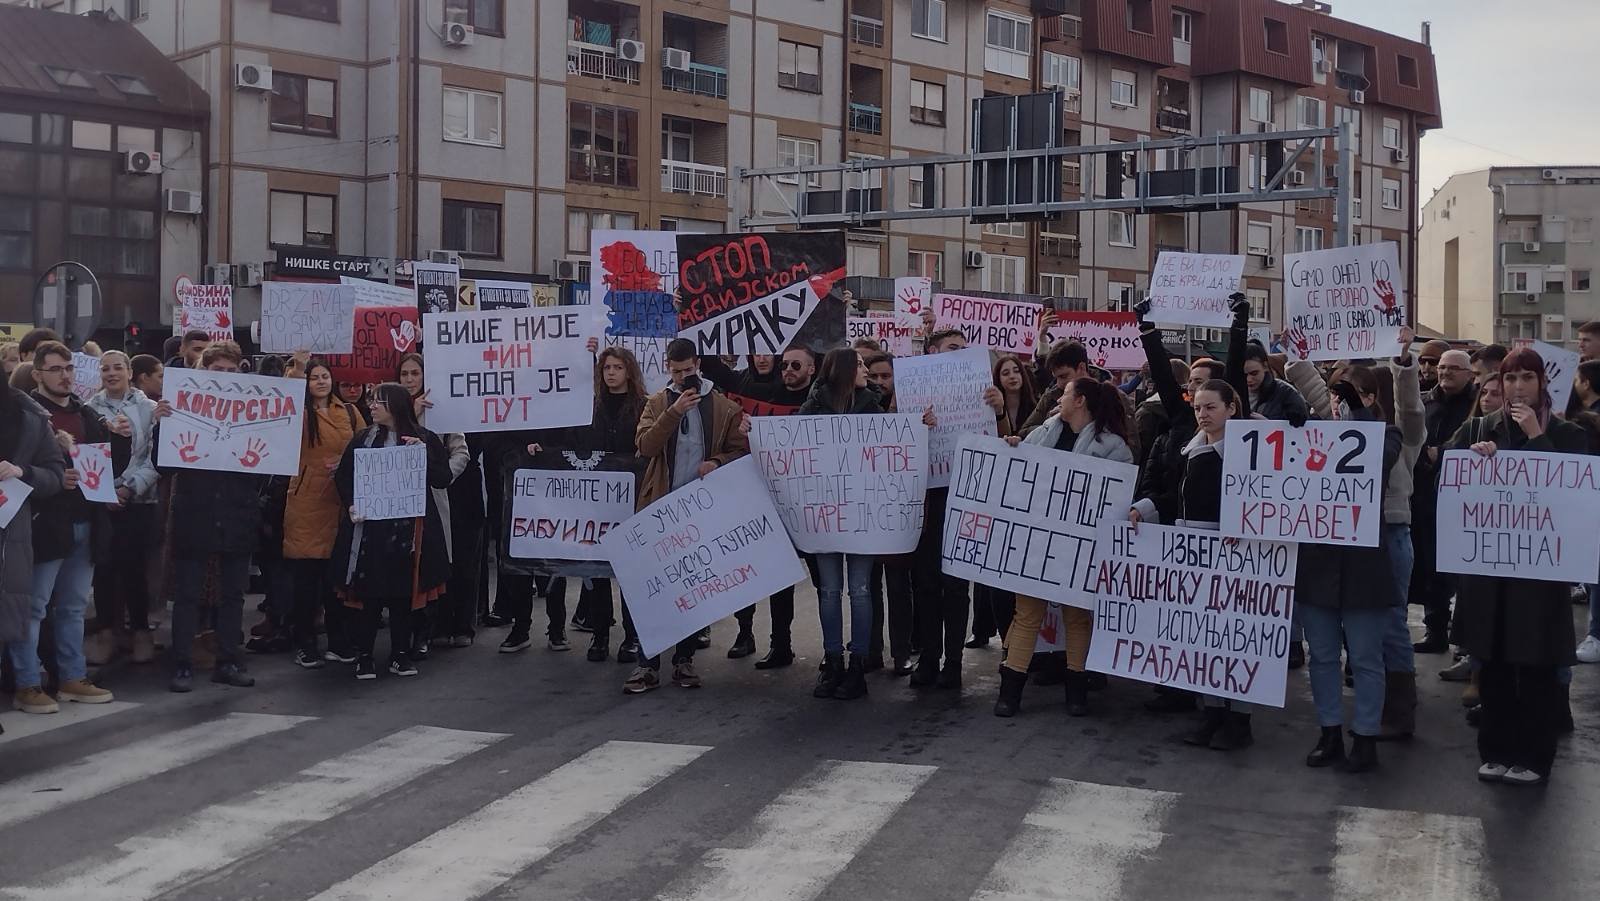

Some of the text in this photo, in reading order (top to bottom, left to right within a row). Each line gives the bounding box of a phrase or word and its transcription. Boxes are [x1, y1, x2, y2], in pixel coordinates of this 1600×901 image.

[285, 257, 370, 273] НИШКЕ СТАРТ
[681, 235, 771, 295] СТОП
[678, 262, 810, 330] МЕДИЈСКОМ
[1307, 290, 1321, 308] СЕ
[364, 311, 402, 328] СМО
[437, 313, 580, 345] ВИШЕ НИЈЕ
[698, 287, 807, 355] МРАКУ
[849, 321, 876, 338] ЗБОГ
[1329, 311, 1342, 330] ДА
[1347, 309, 1376, 329] СВАКО
[357, 328, 379, 346] ОД
[987, 326, 1018, 348] ВАС
[1327, 332, 1340, 351] СЕ
[1348, 330, 1377, 352] КУПИ
[483, 343, 532, 369] ФИН
[450, 367, 571, 398] САДА ЈЕ
[176, 390, 297, 422] KORUPCIJA
[481, 397, 532, 423] ЉУТ
[759, 417, 825, 447] ГАЗИТЕ
[832, 416, 851, 443] ПО
[857, 416, 916, 443] НАМА
[759, 448, 821, 477] ГАЗИТЕ
[838, 448, 850, 473] И
[860, 445, 918, 473] МРТВЕ
[515, 477, 630, 503] НЕ ЛАЖИТЕ МИ
[864, 474, 922, 504] НАЗАД
[1225, 474, 1374, 503] РУКЕ СУ ВАМ
[1495, 490, 1538, 504] ТО ЈЕ
[626, 487, 714, 551] НЕ УЧИМО
[804, 503, 849, 533] ПАРЕ
[854, 502, 874, 534] ДА
[877, 504, 895, 531] СЕ
[1241, 501, 1362, 541] КРВАВЕ!
[1462, 502, 1555, 531] МИЛИНА
[646, 514, 774, 599] ДА БИСМО ЋУТАЛИ
[1112, 525, 1288, 577] НЕ ИЗБЕГАВАМО
[1462, 530, 1562, 571] ЈЕДНА!
[674, 564, 758, 613] НЕПРАВДОМ
[682, 568, 718, 590] ПРЕД
[1097, 599, 1288, 659] НЕГО ИСПУЊАВАМО
[1112, 638, 1260, 694] ГРАЂАНСКУ
